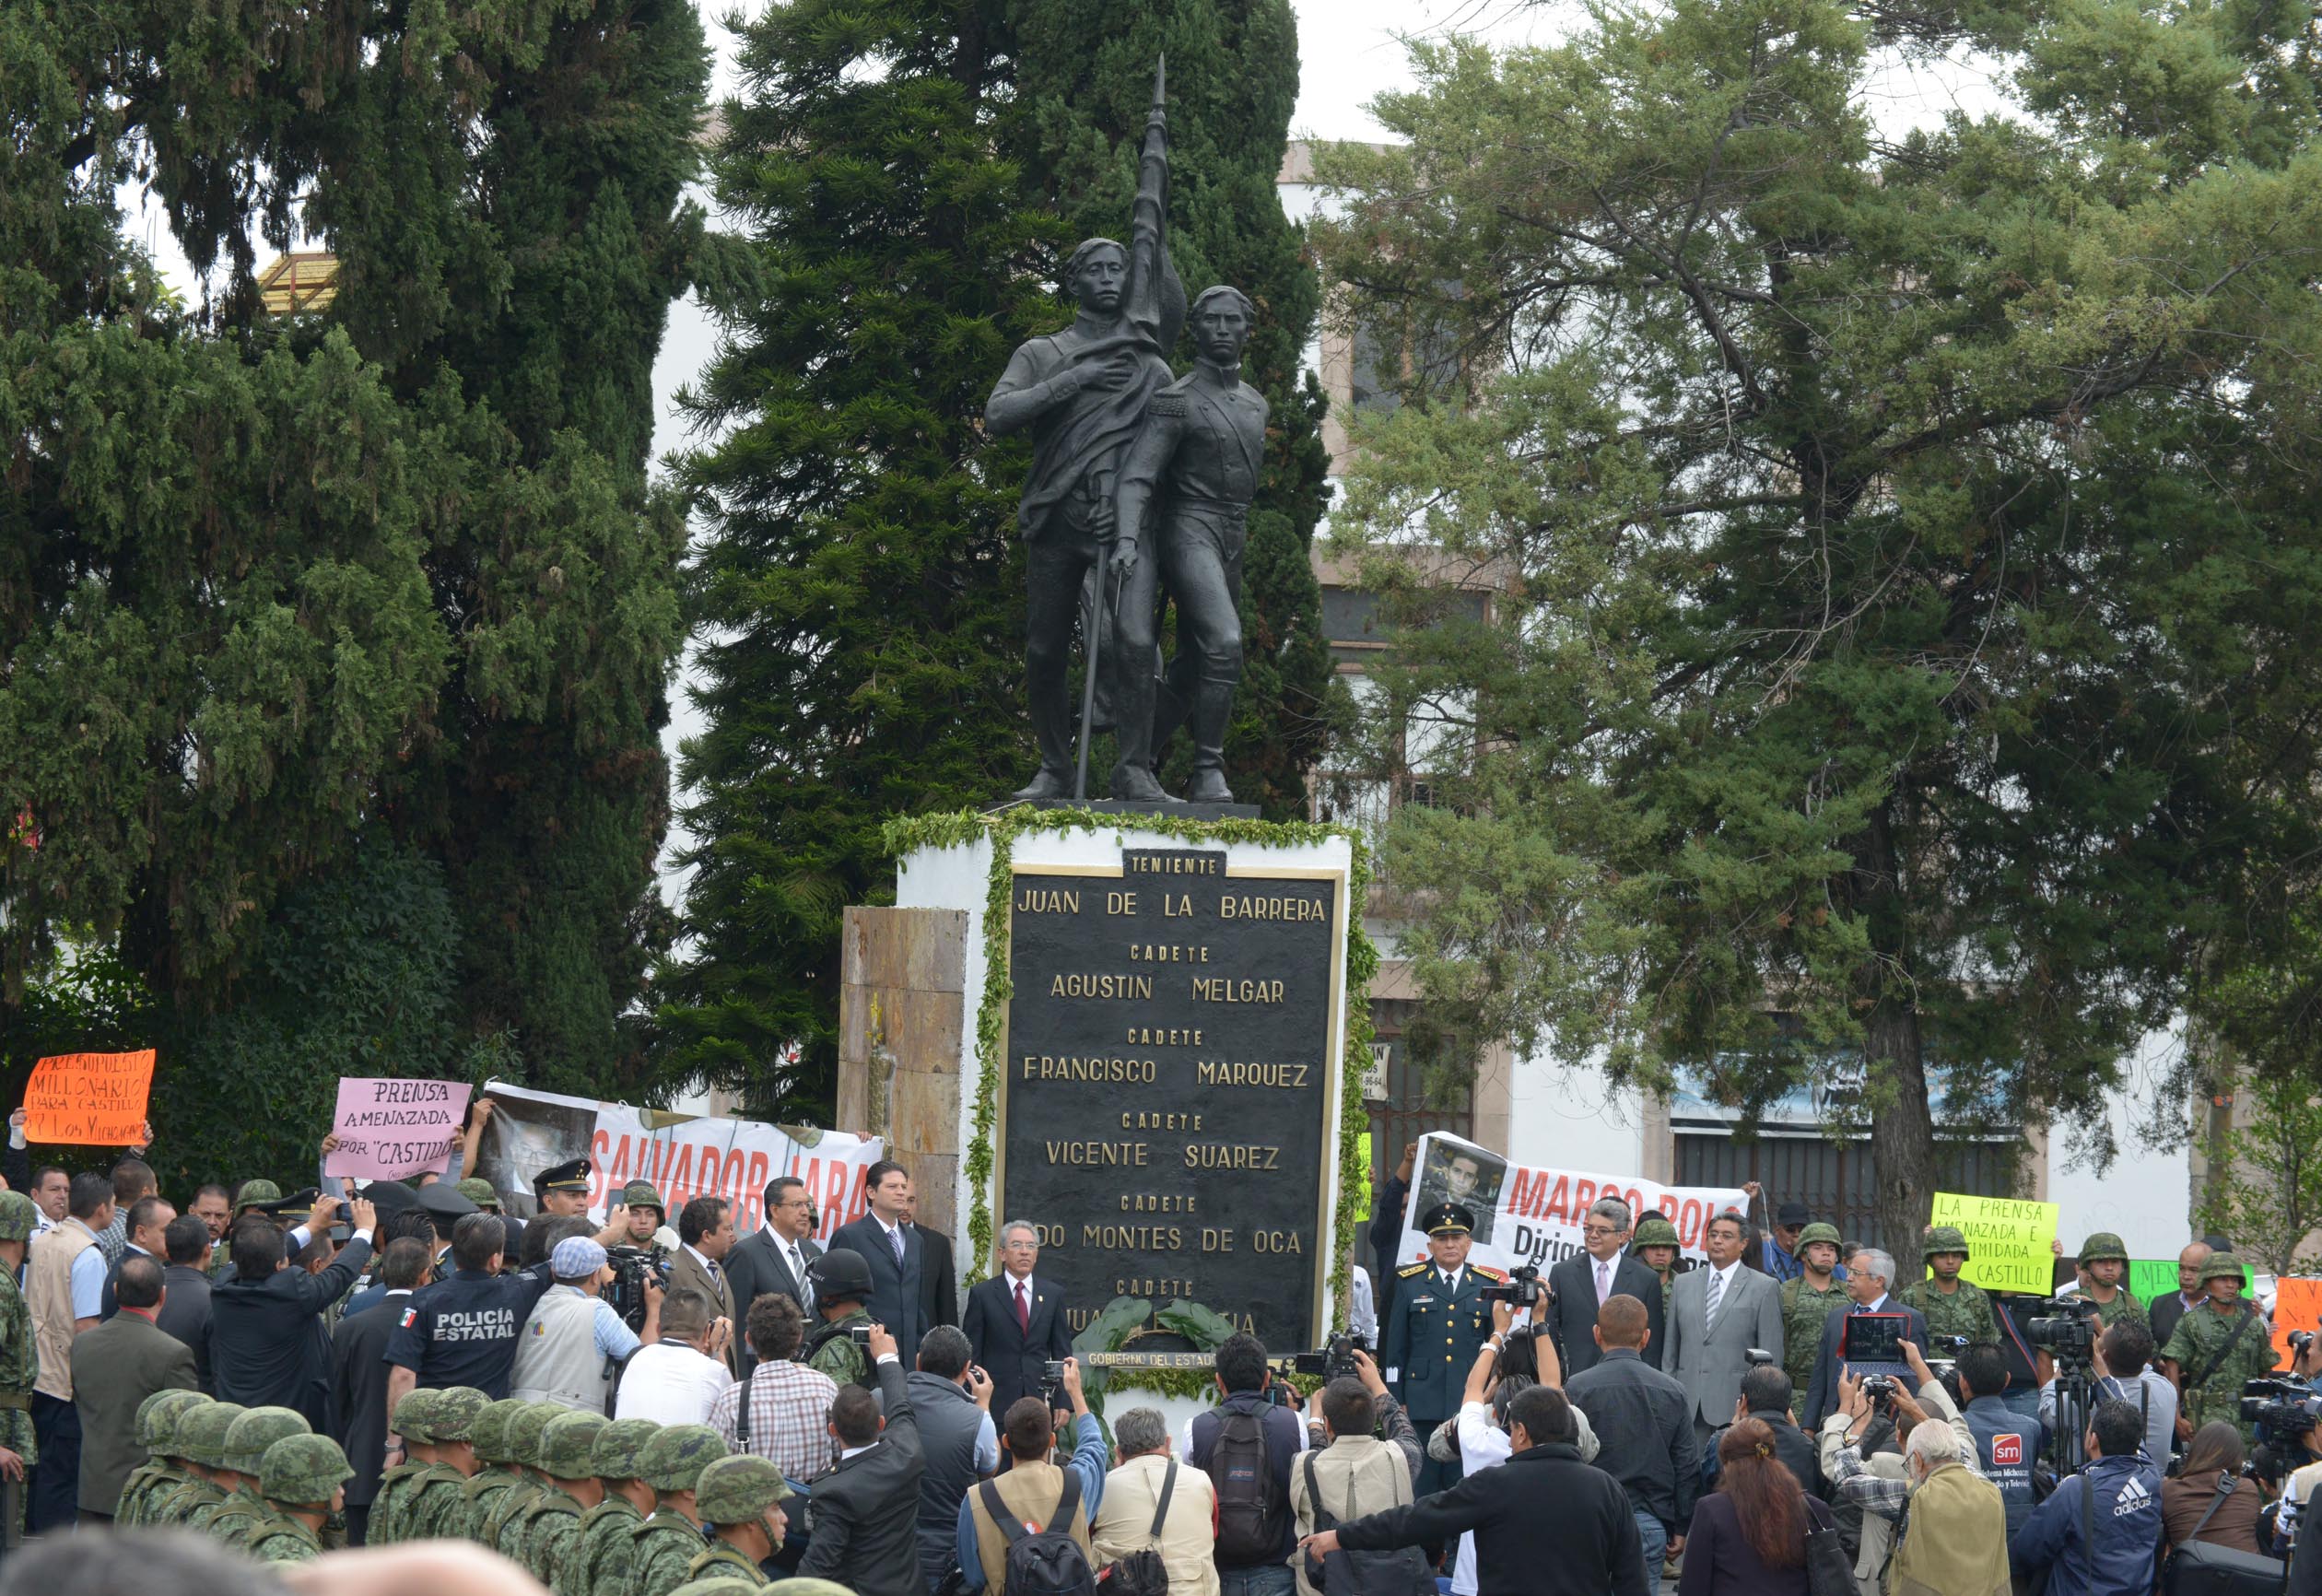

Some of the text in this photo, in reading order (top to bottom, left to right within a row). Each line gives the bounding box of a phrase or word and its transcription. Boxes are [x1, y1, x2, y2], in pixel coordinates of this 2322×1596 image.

[1132, 857, 1216, 874] TENIENTE
[1017, 890, 1325, 921] JUAN DE LA BARRERA
[1130, 945, 1209, 963] CADETE
[1050, 974, 1284, 1003] AGUSTIN MELGAR
[1127, 1028, 1202, 1046] CADETE
[1024, 1056, 1308, 1087] FRANCISCO MARQUEZ
[31, 1074, 141, 1097] MILLONARIO
[373, 1082, 449, 1103] PRENSA
[31, 1095, 68, 1110] PARA
[344, 1109, 452, 1127] AMENAZADA
[1121, 1112, 1202, 1131] CADETE
[337, 1140, 369, 1155] POR
[1047, 1141, 1281, 1170] VICENTE SUAREZ
[586, 1129, 768, 1231] SALVADOR
[1120, 1195, 1196, 1213] CADETE
[1940, 1197, 2042, 1221] LA PRENSA
[1083, 1225, 1181, 1250] MONTES
[1202, 1228, 1234, 1252] DE
[1253, 1230, 1301, 1254] OCA
[2030, 1226, 2038, 1242] E
[1976, 1264, 2043, 1285] CASTILLO
[1117, 1279, 1192, 1297] CADETE
[438, 1308, 514, 1328] POLICÍA
[433, 1323, 515, 1342] ESTATAL
[1088, 1353, 1146, 1366] GOBIERNO
[1149, 1354, 1171, 1366] DEL
[1997, 1447, 2019, 1459] sm
[2114, 1496, 2152, 1517] adidas
